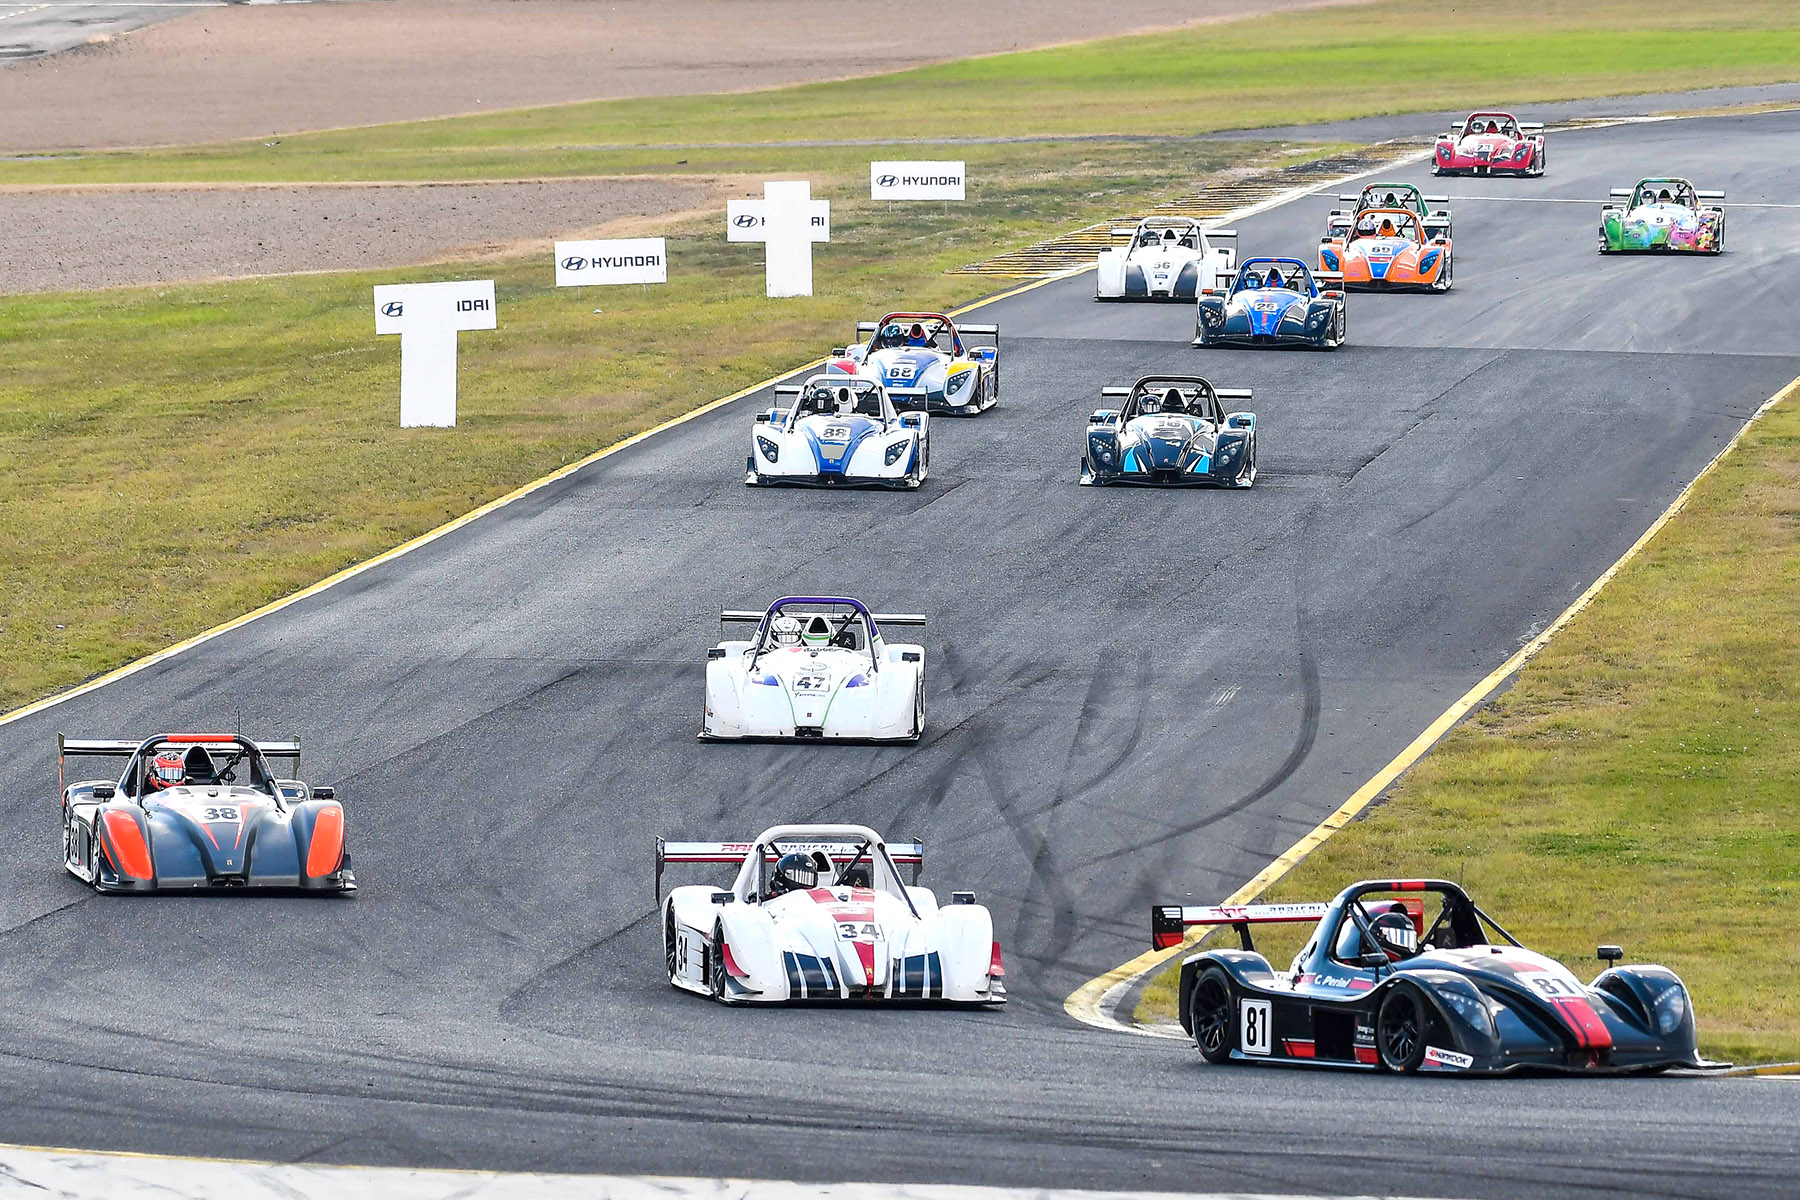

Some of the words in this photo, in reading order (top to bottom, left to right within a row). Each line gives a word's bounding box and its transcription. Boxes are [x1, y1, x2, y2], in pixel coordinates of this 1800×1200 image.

[902, 176, 960, 187] HYUNDAI
[592, 255, 660, 268] HYUNDAI
[796, 676, 826, 689] 47
[203, 807, 238, 820] 38
[838, 924, 880, 939] 34
[678, 935, 688, 973] 34
[1531, 978, 1576, 995] 81
[1246, 1006, 1267, 1048] 81
